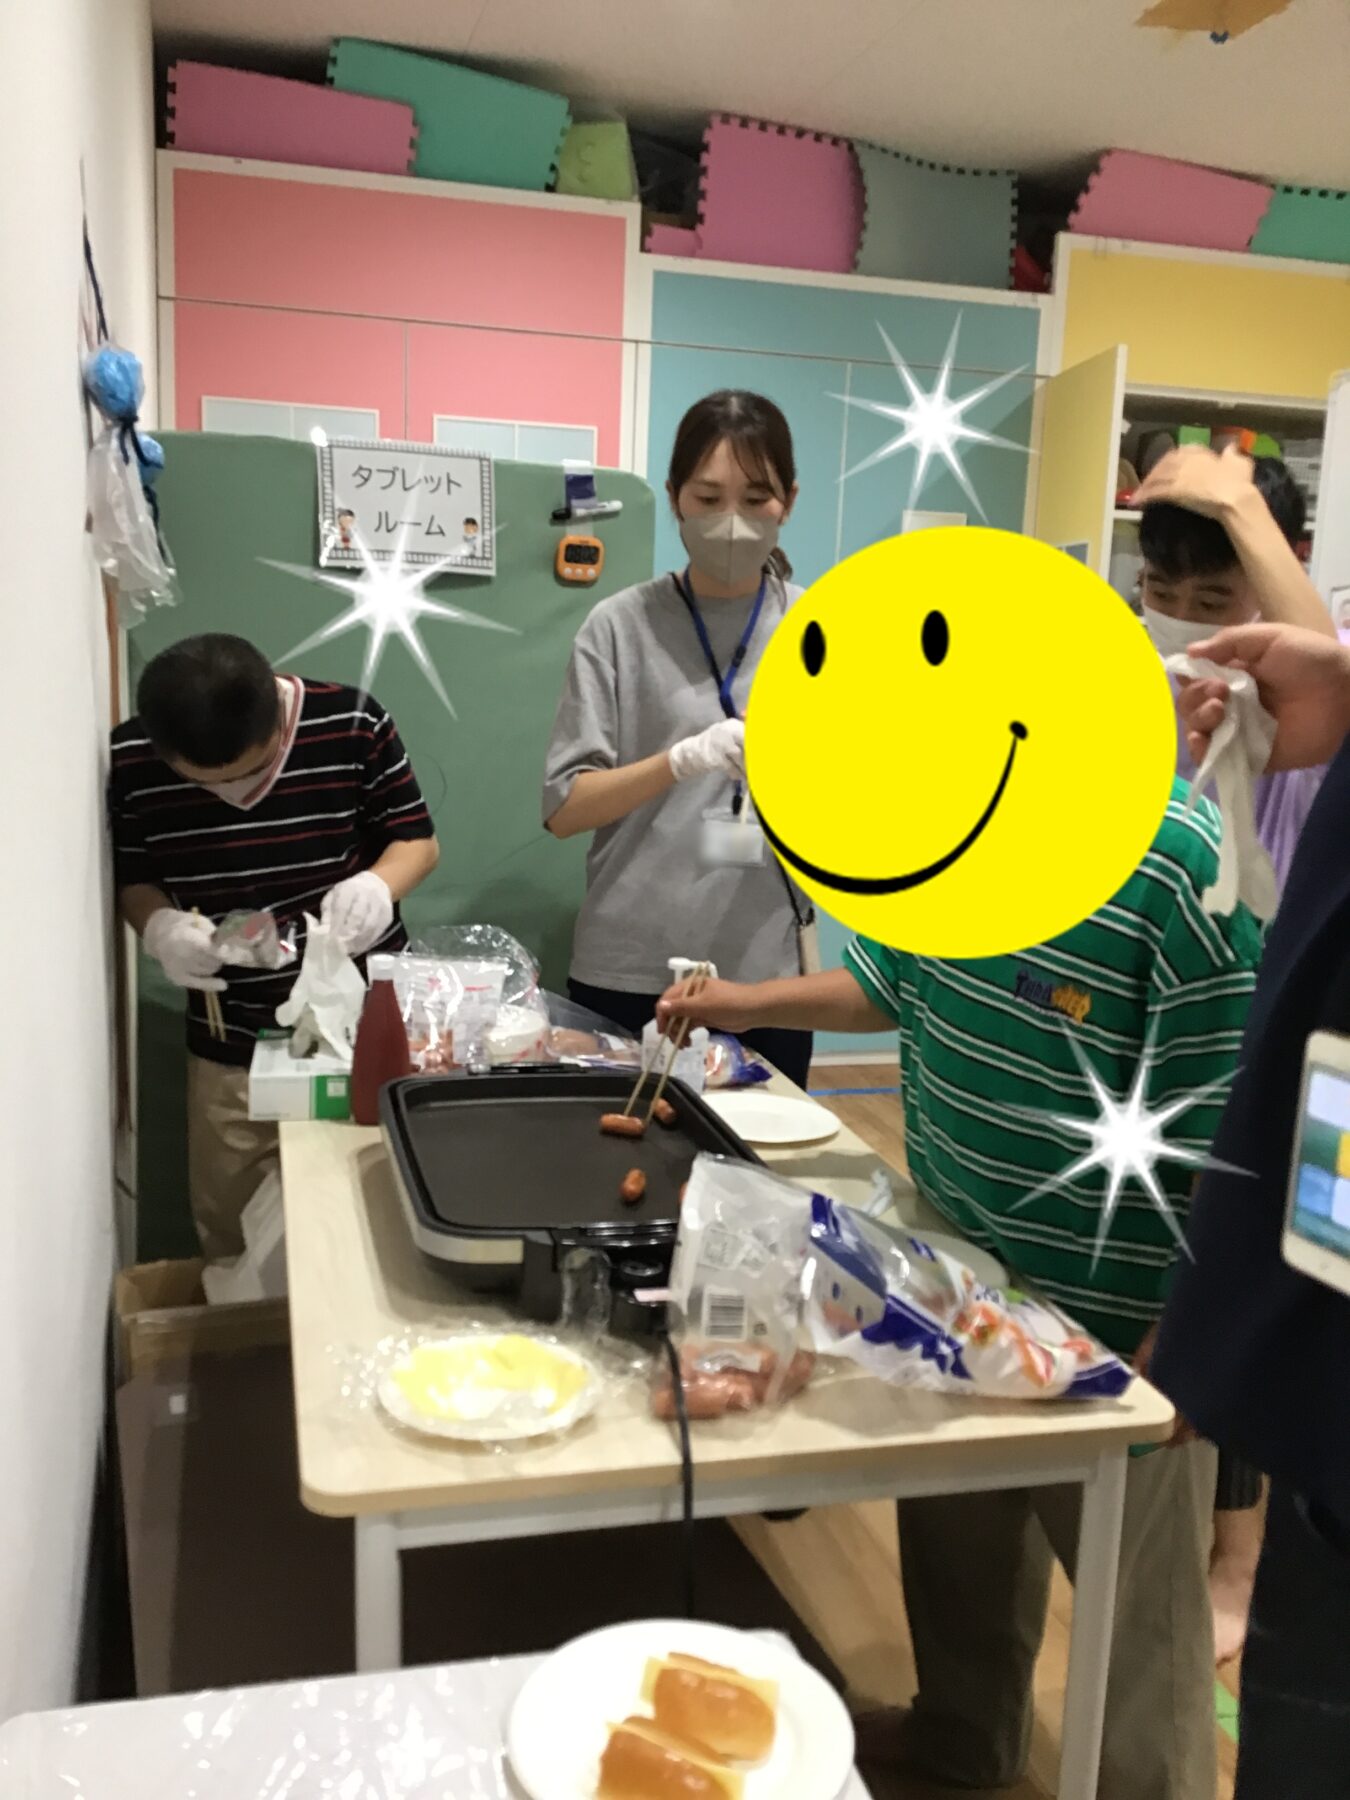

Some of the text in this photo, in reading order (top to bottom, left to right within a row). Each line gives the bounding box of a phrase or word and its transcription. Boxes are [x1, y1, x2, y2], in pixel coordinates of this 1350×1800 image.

[352, 464, 462, 495] タブレット
[374, 511, 446, 537] ルーム
